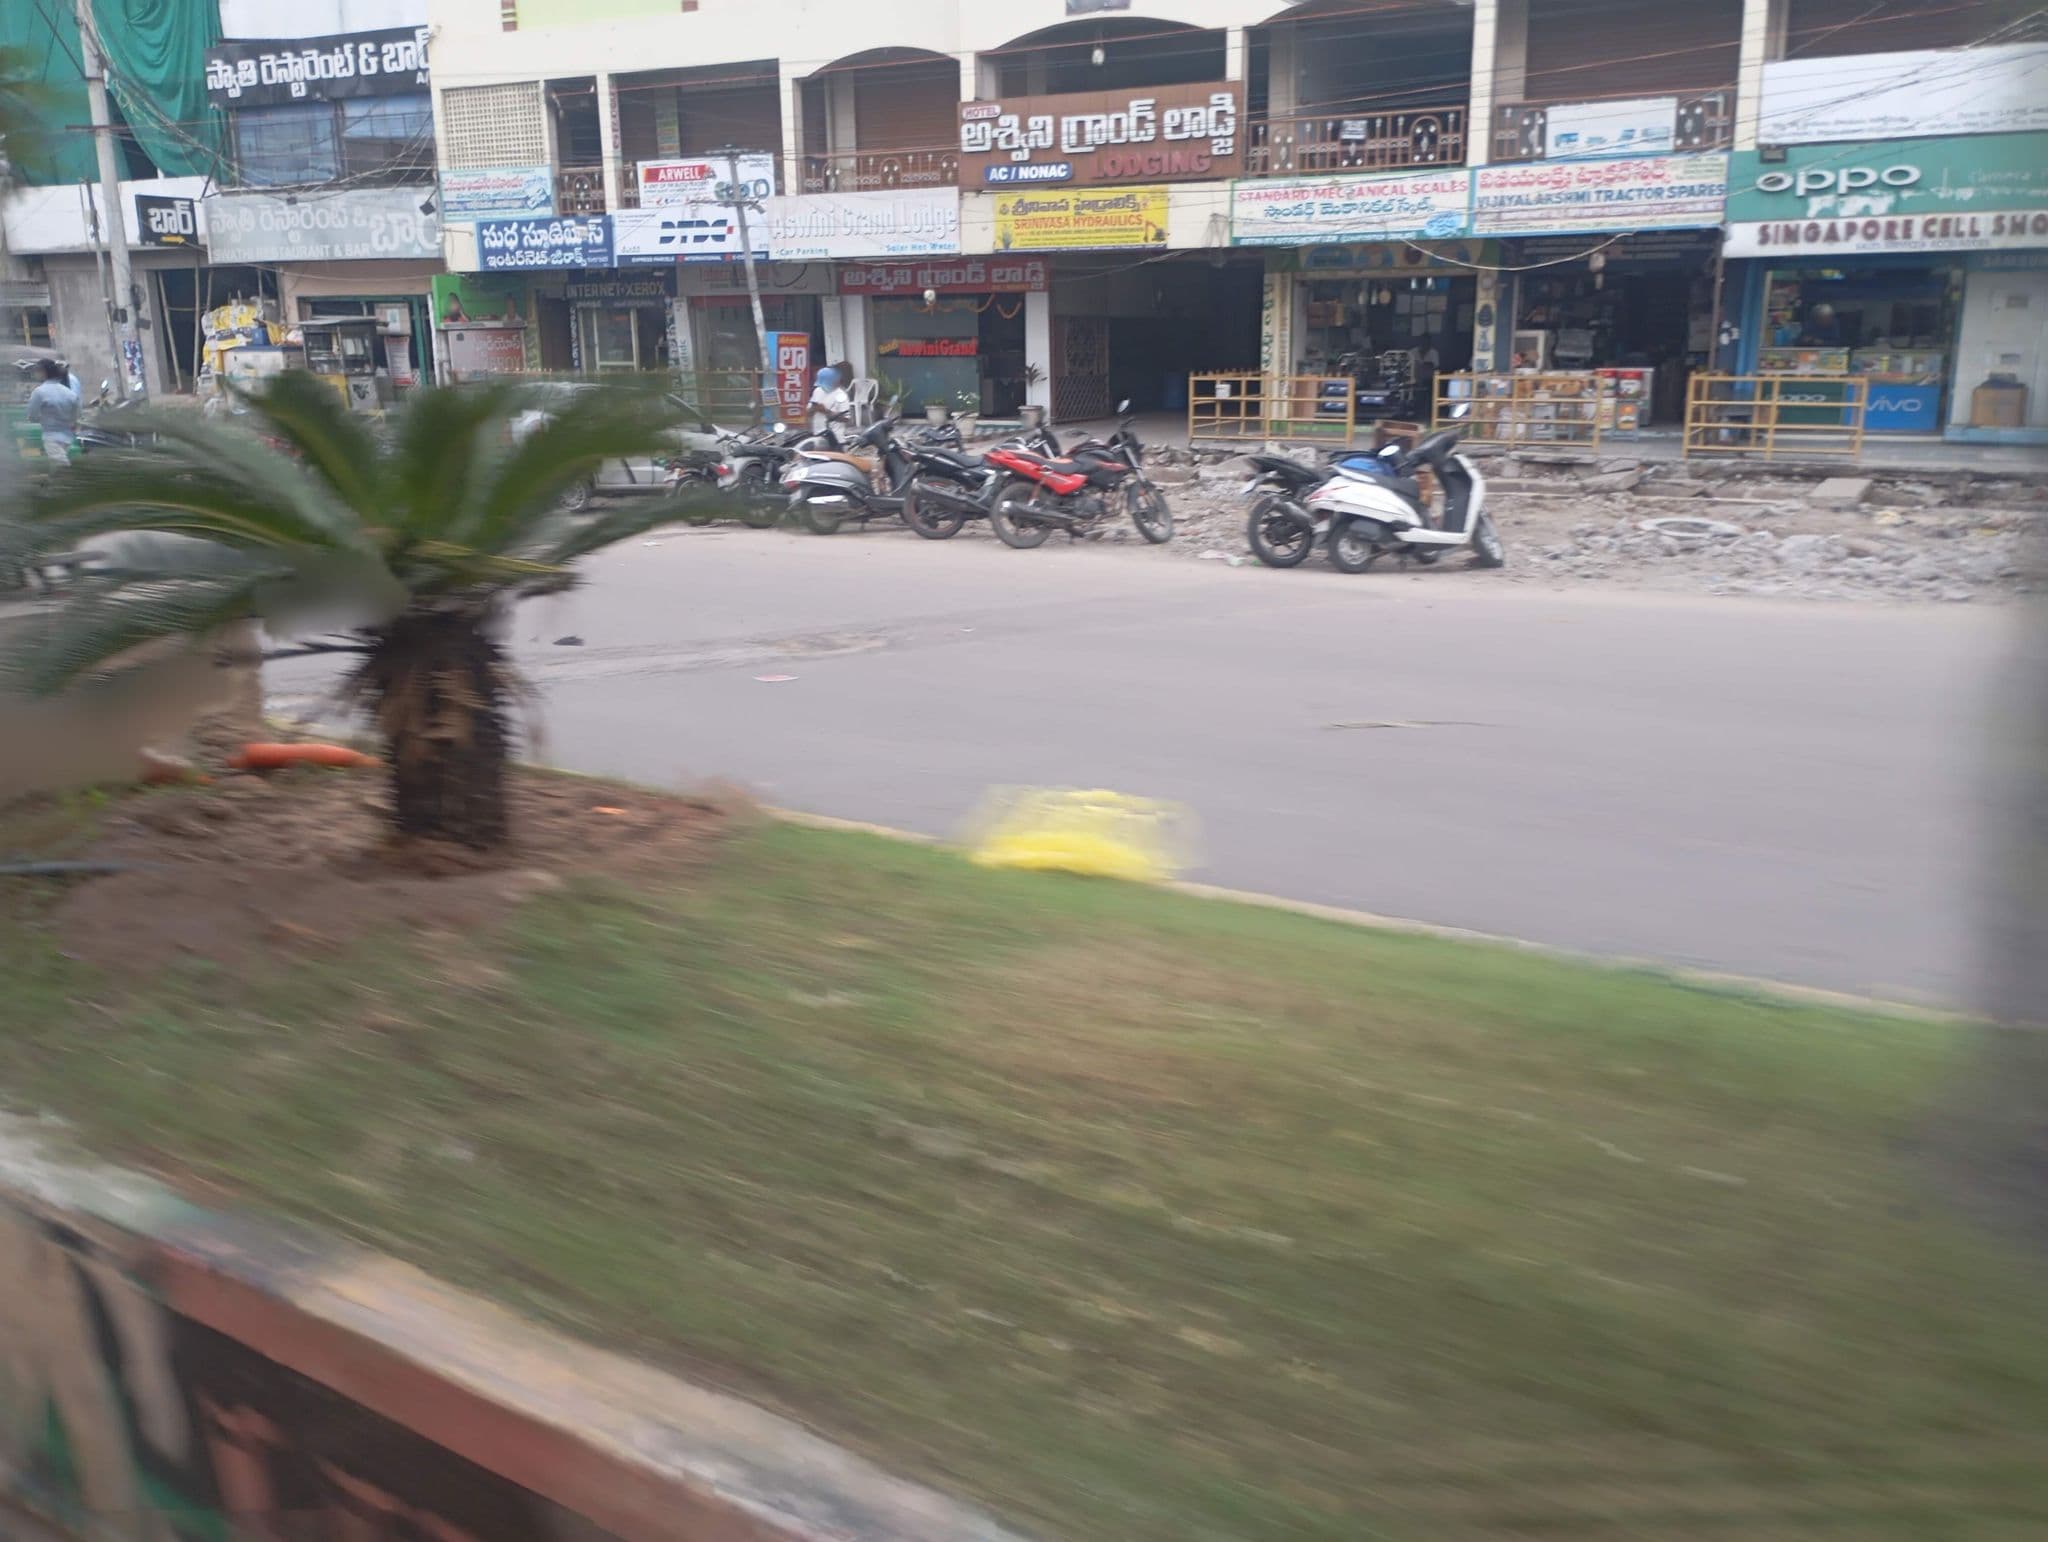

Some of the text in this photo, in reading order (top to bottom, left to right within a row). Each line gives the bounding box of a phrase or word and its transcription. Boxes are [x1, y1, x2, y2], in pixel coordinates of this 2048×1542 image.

[206, 59, 257, 98] స్వాతి
[260, 45, 355, 98] రెస్టారెంట్
[359, 43, 378, 75] &
[964, 106, 999, 119] HOTEL
[960, 113, 1054, 161] అశ్విని
[1061, 98, 1156, 153] గ్రాండ్
[658, 166, 701, 181] ARWELL
[989, 168, 1008, 181] AC
[1018, 164, 1069, 179] NONAC
[1091, 152, 1212, 179] LODGING
[1238, 180, 1468, 203] STANDARD MECANICAL SCALES
[1477, 183, 1726, 209] VIJAYALAKSHMI TRACTOR SPARES
[149, 201, 193, 235] బార్
[842, 203, 897, 237] Grand
[901, 199, 958, 239] Lodge
[1014, 216, 1072, 232] SRINIVASA
[1073, 214, 1143, 229] HYDRAULICS
[659, 219, 729, 245] DTDC
[1758, 219, 1914, 246] SINGAPORE
[1922, 216, 1980, 239] CELL
[256, 244, 331, 259] RESTAURANT
[345, 242, 370, 257] BAR
[797, 247, 828, 258] Parking
[929, 242, 957, 250] Water
[917, 261, 985, 289] గ్రాండ్
[566, 281, 665, 297] INTERNET XEROX
